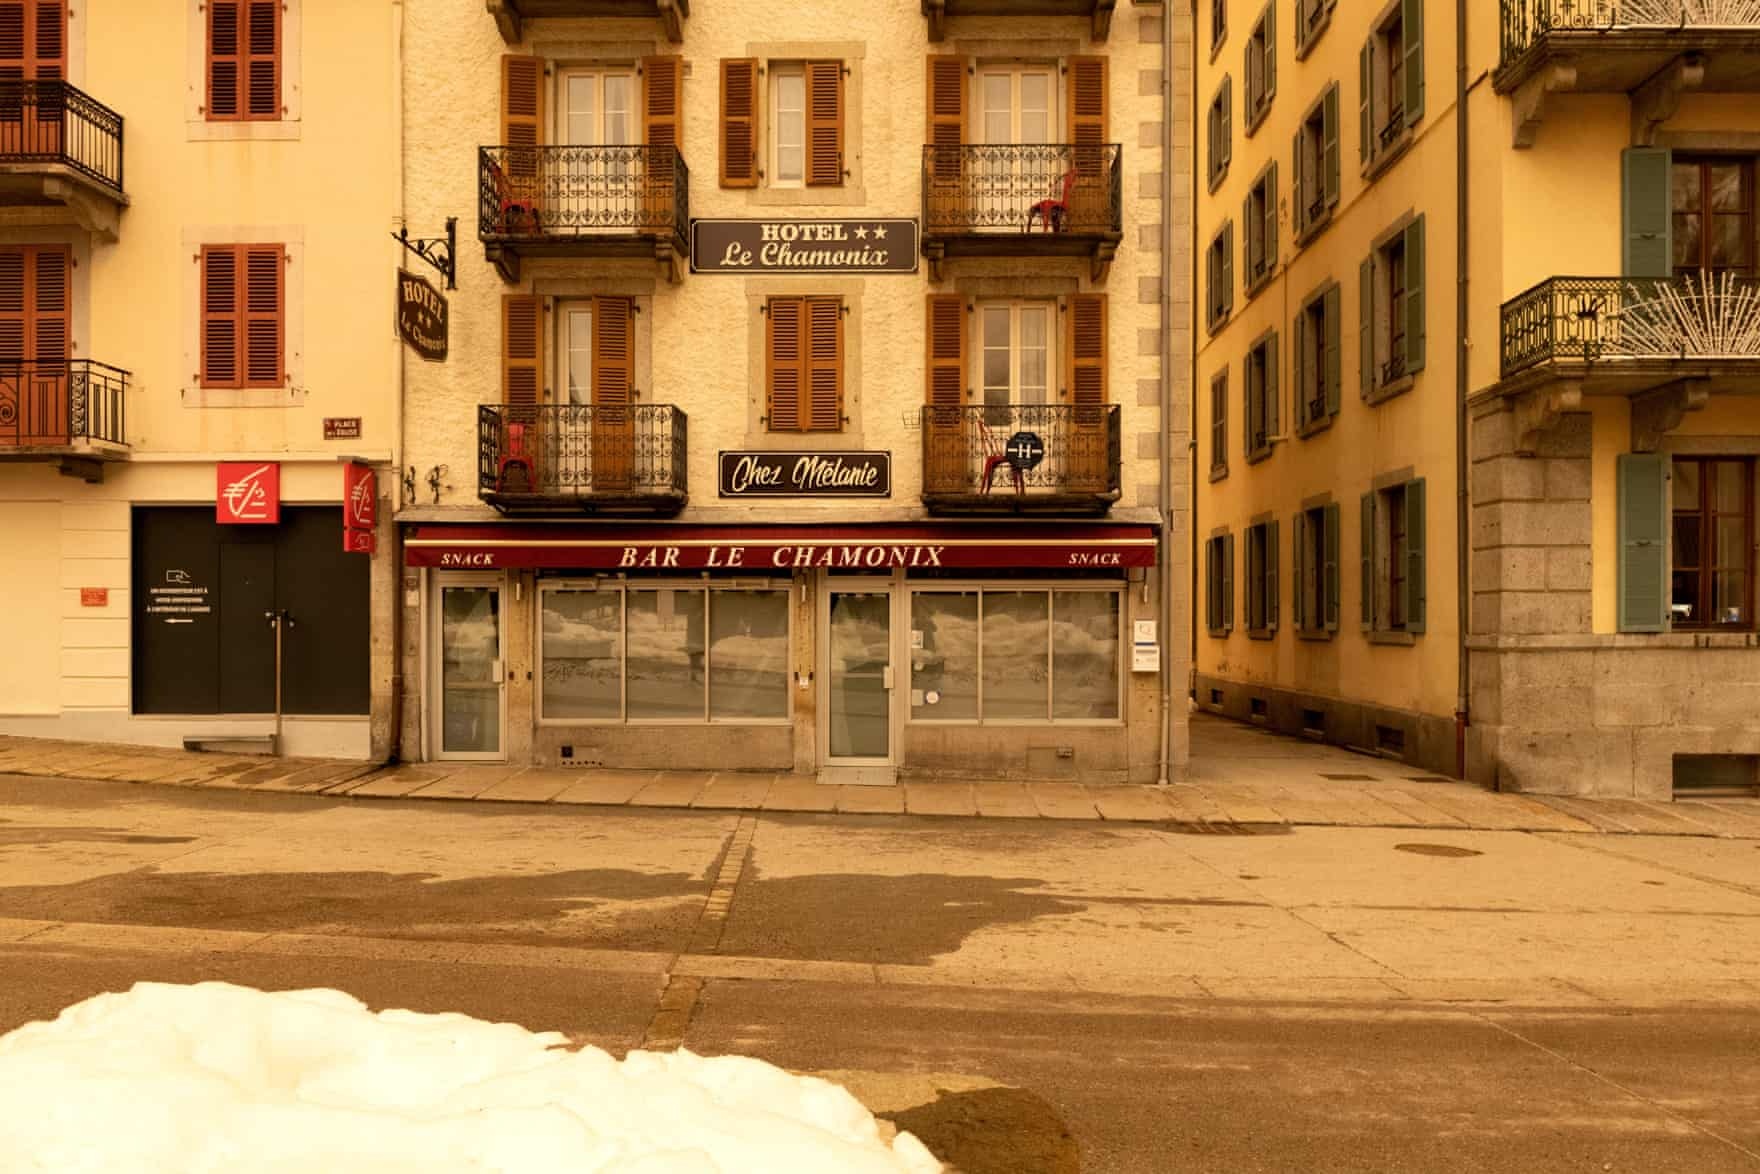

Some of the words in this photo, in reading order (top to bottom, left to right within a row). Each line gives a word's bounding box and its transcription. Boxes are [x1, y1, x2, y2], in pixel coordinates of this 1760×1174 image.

[761, 224, 848, 241] HOTEL
[720, 242, 753, 266] Le
[760, 242, 888, 266] Chamonix
[403, 280, 442, 321] HOTEL
[1018, 443, 1031, 458] H
[732, 455, 784, 492] Chez
[792, 455, 878, 489] Mélanie
[441, 552, 495, 565] SNACK
[618, 547, 680, 567] BAR
[705, 547, 744, 567] LE
[772, 546, 944, 567] CHAMONIX
[1068, 552, 1121, 565] SNACK
